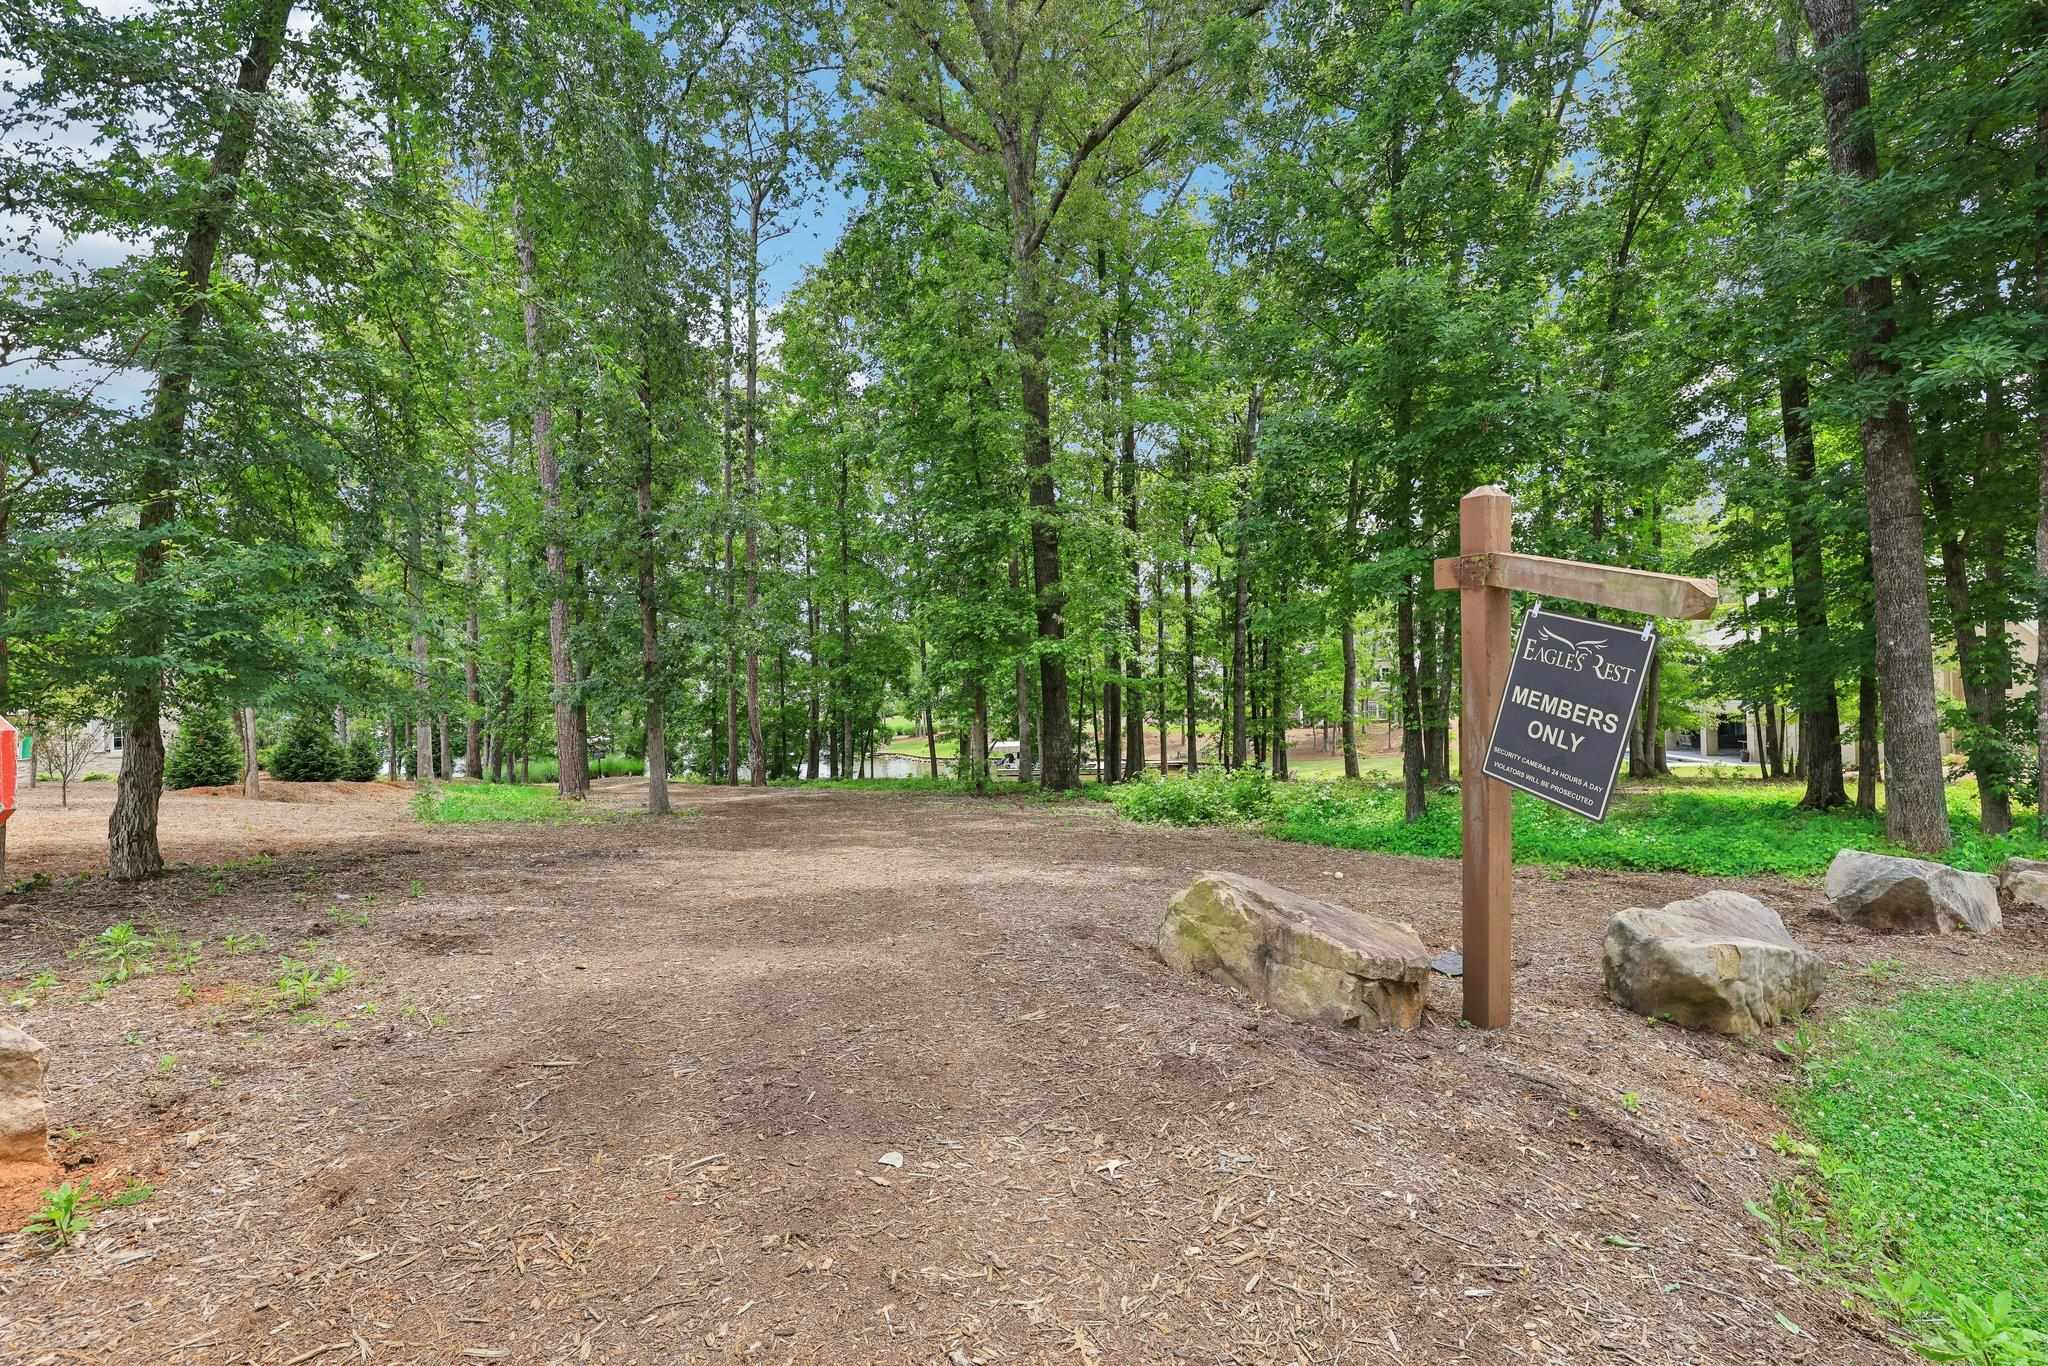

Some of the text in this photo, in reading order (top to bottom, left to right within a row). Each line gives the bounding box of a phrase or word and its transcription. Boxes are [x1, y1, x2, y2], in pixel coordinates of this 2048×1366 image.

[1511, 685, 1619, 734] MEMBERS
[1527, 720, 1585, 753] ONLY
[1493, 746, 1521, 761] SECURITY
[1521, 757, 1551, 773] CAMERAS
[1551, 768, 1559, 777] 24
[1559, 771, 1582, 786] HOURS
[1589, 784, 1603, 793] DAY
[1493, 761, 1594, 807] VIOLATORS WILL BE PROSECUTED
